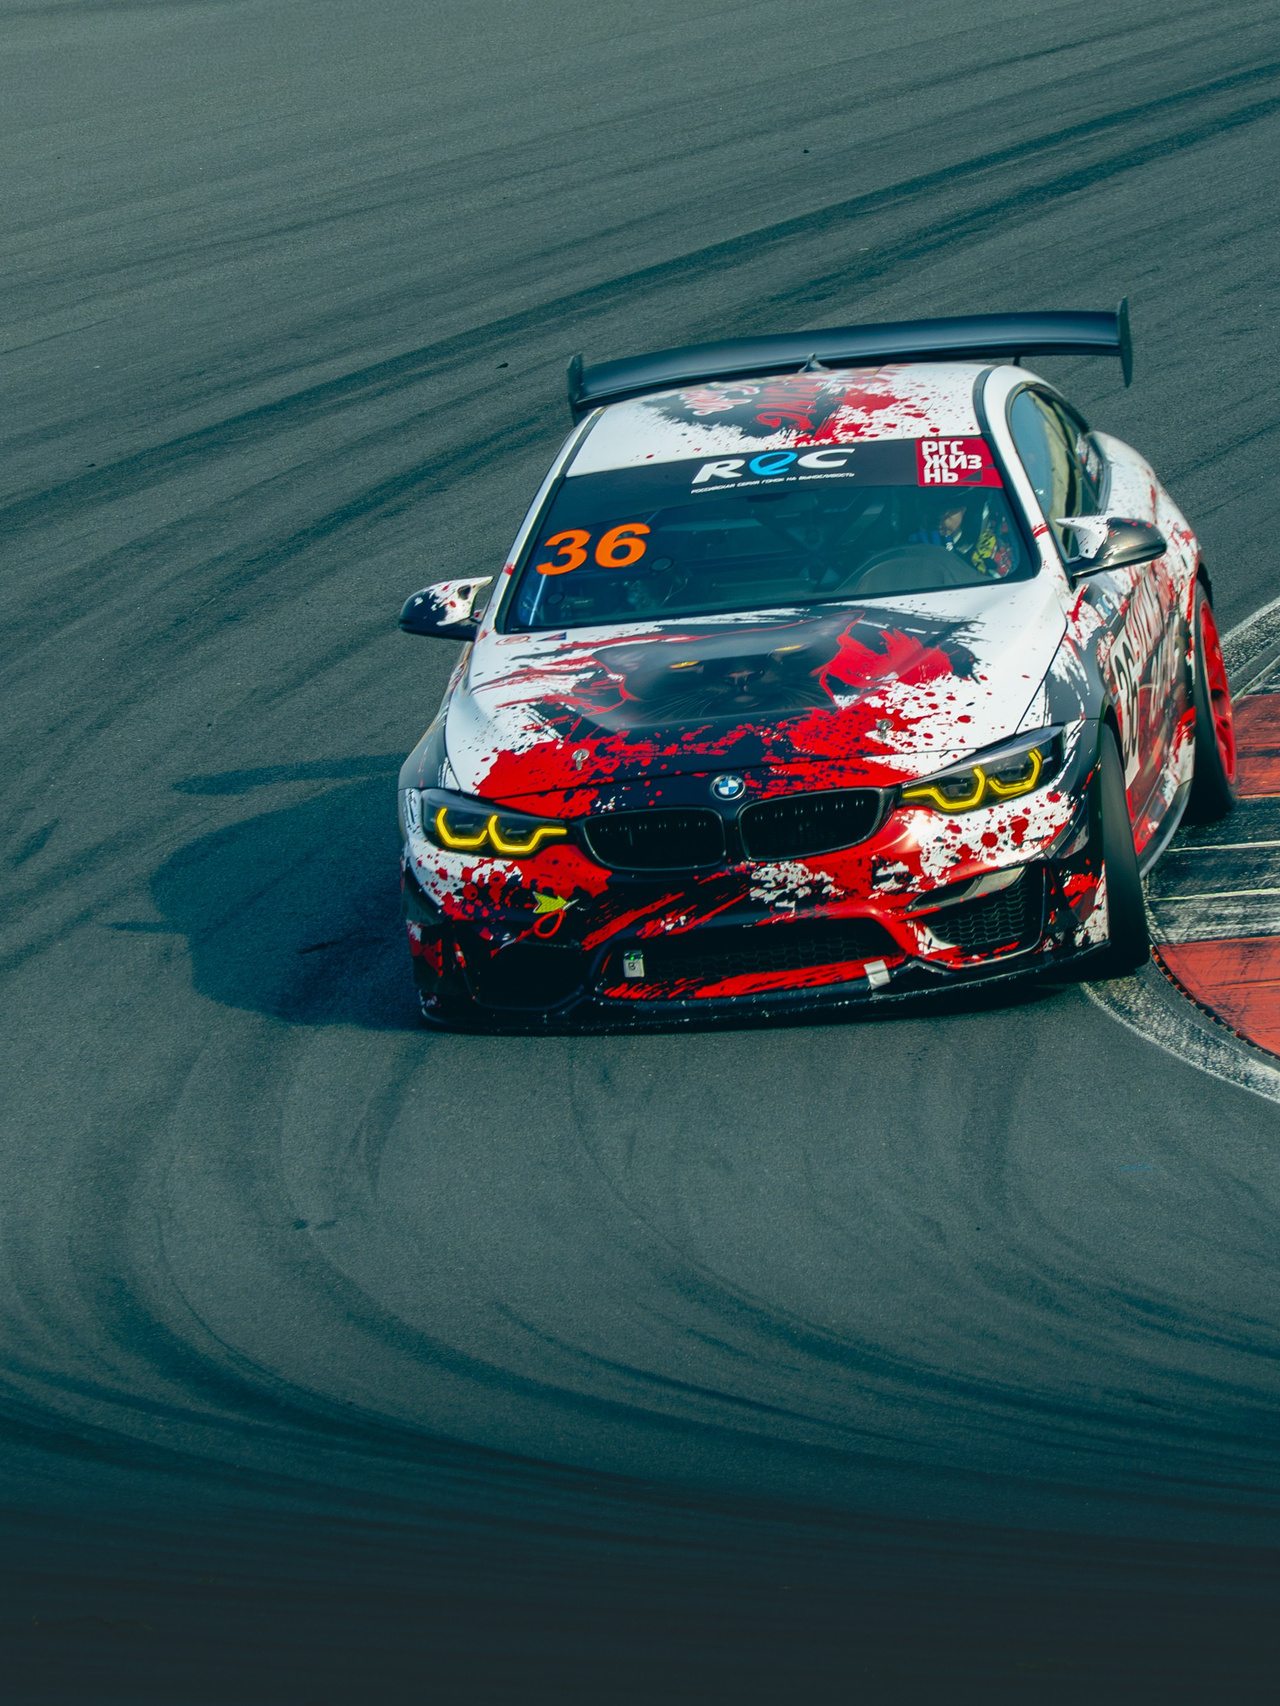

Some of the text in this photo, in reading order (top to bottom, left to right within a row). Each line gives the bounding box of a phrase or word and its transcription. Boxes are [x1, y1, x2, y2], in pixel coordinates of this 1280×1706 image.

[921, 440, 965, 455] РГС
[923, 454, 983, 470] ЖИЗ
[923, 468, 959, 484] НЬ
[535, 522, 651, 576] 36
